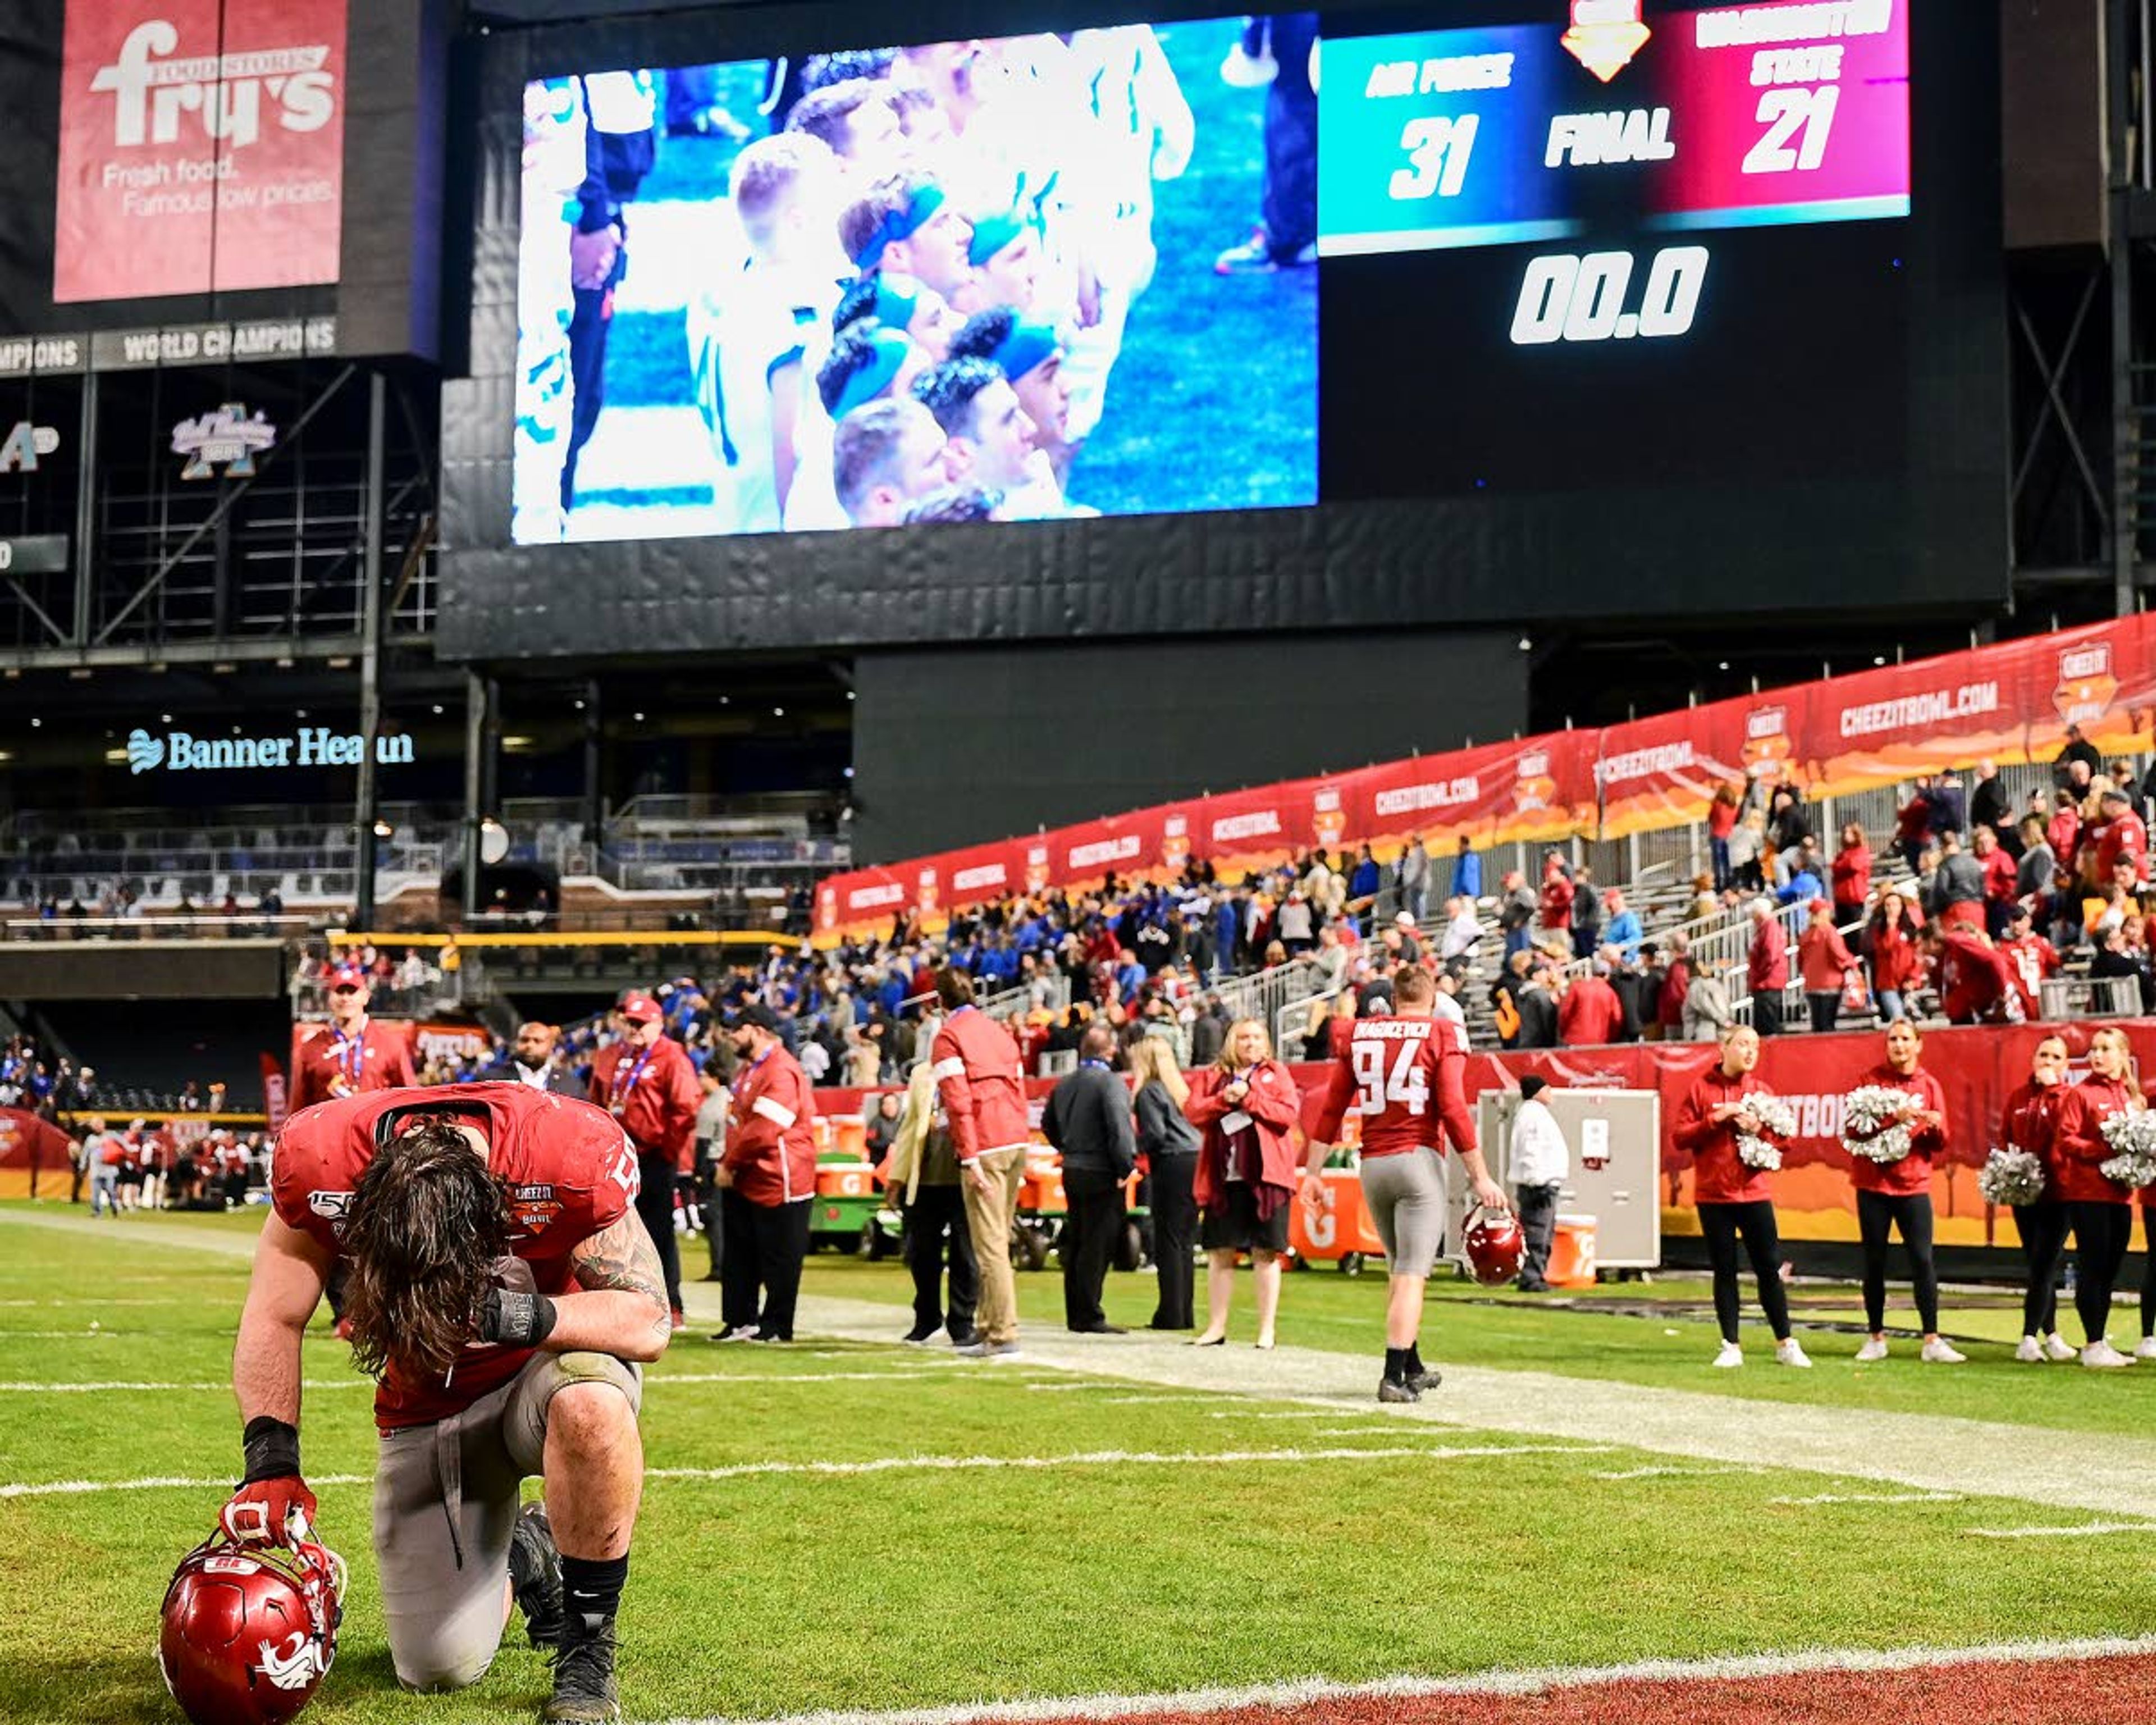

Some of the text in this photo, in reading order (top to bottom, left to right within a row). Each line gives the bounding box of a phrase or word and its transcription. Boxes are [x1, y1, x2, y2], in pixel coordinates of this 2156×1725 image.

[90, 20, 335, 148] fry's
[153, 48, 321, 83] FOOD STORES
[1365, 52, 1515, 98] AIR FORCE
[1750, 45, 1844, 86] STATE
[1388, 113, 1479, 200] 31
[1545, 108, 1675, 167] FINAL
[1742, 85, 1840, 174] 21
[103, 159, 170, 188] Fresh
[1510, 245, 1709, 344] 00.0
[124, 322, 334, 362] WORLD CHAMPIONS
[1840, 682, 1998, 737] CHEEZITBOWL.COM
[168, 732, 294, 769] Banner
[1351, 1039, 1429, 1115] 94
